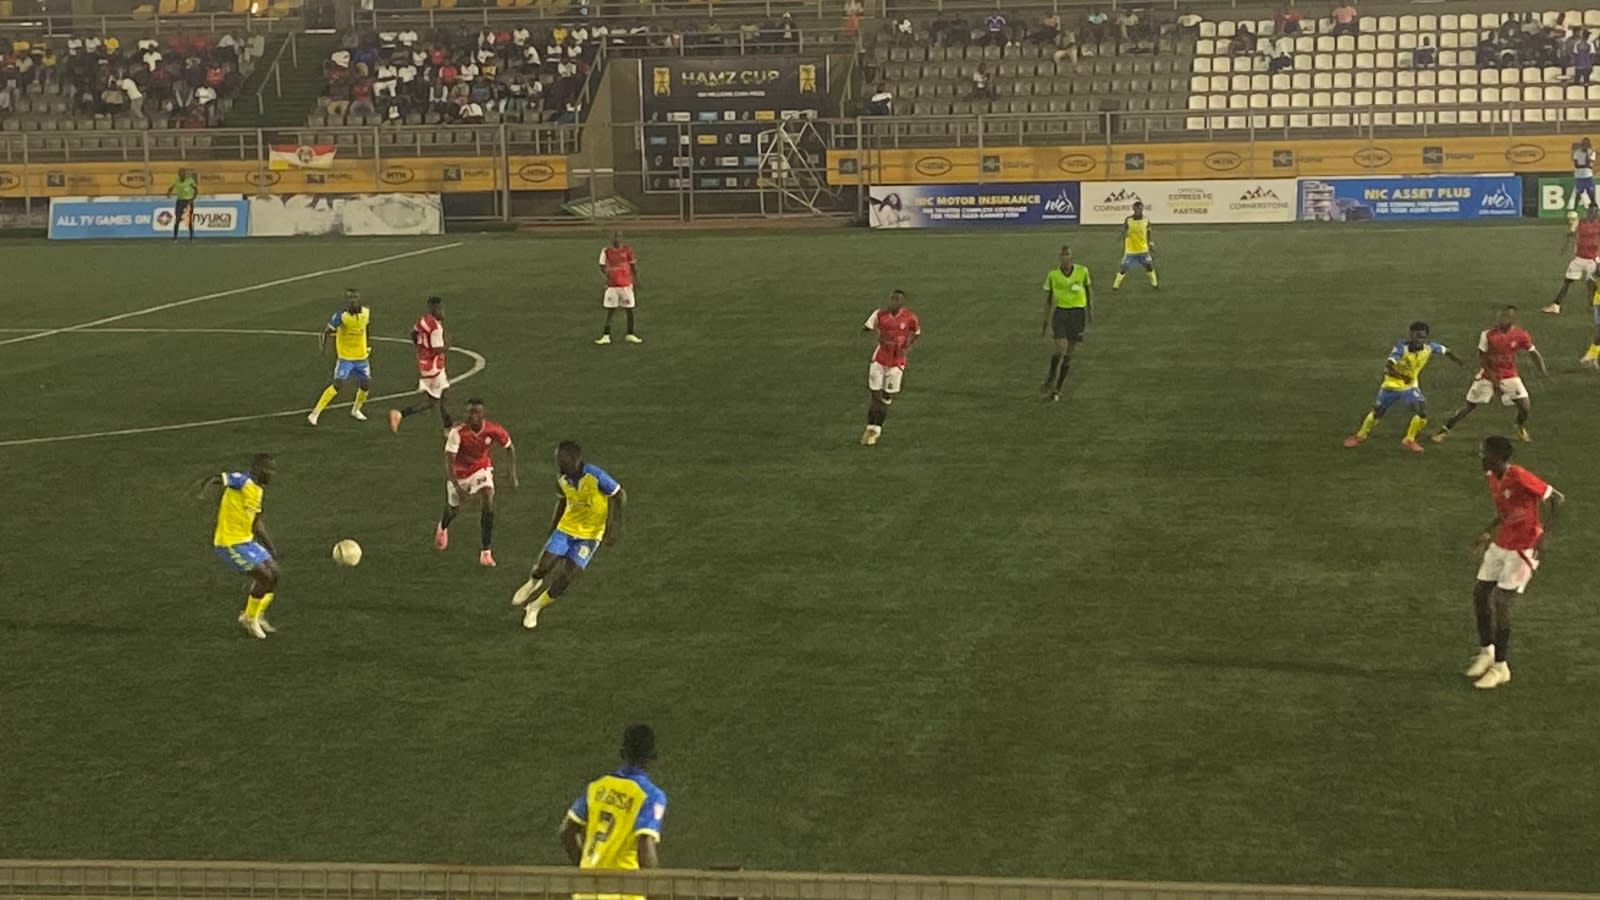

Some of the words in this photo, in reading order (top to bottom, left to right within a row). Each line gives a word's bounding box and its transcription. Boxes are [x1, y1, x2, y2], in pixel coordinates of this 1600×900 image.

[681, 71, 737, 86] HAMZ
[740, 70, 780, 85] CUP
[386, 171, 406, 180] MTN
[1202, 192, 1213, 200] FC
[1364, 188, 1389, 199] NIC
[1392, 188, 1434, 199] ASSET
[1438, 187, 1471, 198] PLUS
[936, 196, 975, 206] MOTOR
[978, 195, 1041, 205] INSURANCE
[1229, 201, 1289, 210] CORNERSTONE
[1173, 207, 1208, 215] PARTNER
[56, 215, 77, 226] ALL
[79, 215, 95, 226] TV
[95, 215, 132, 226] GAMES
[135, 214, 150, 225] ON
